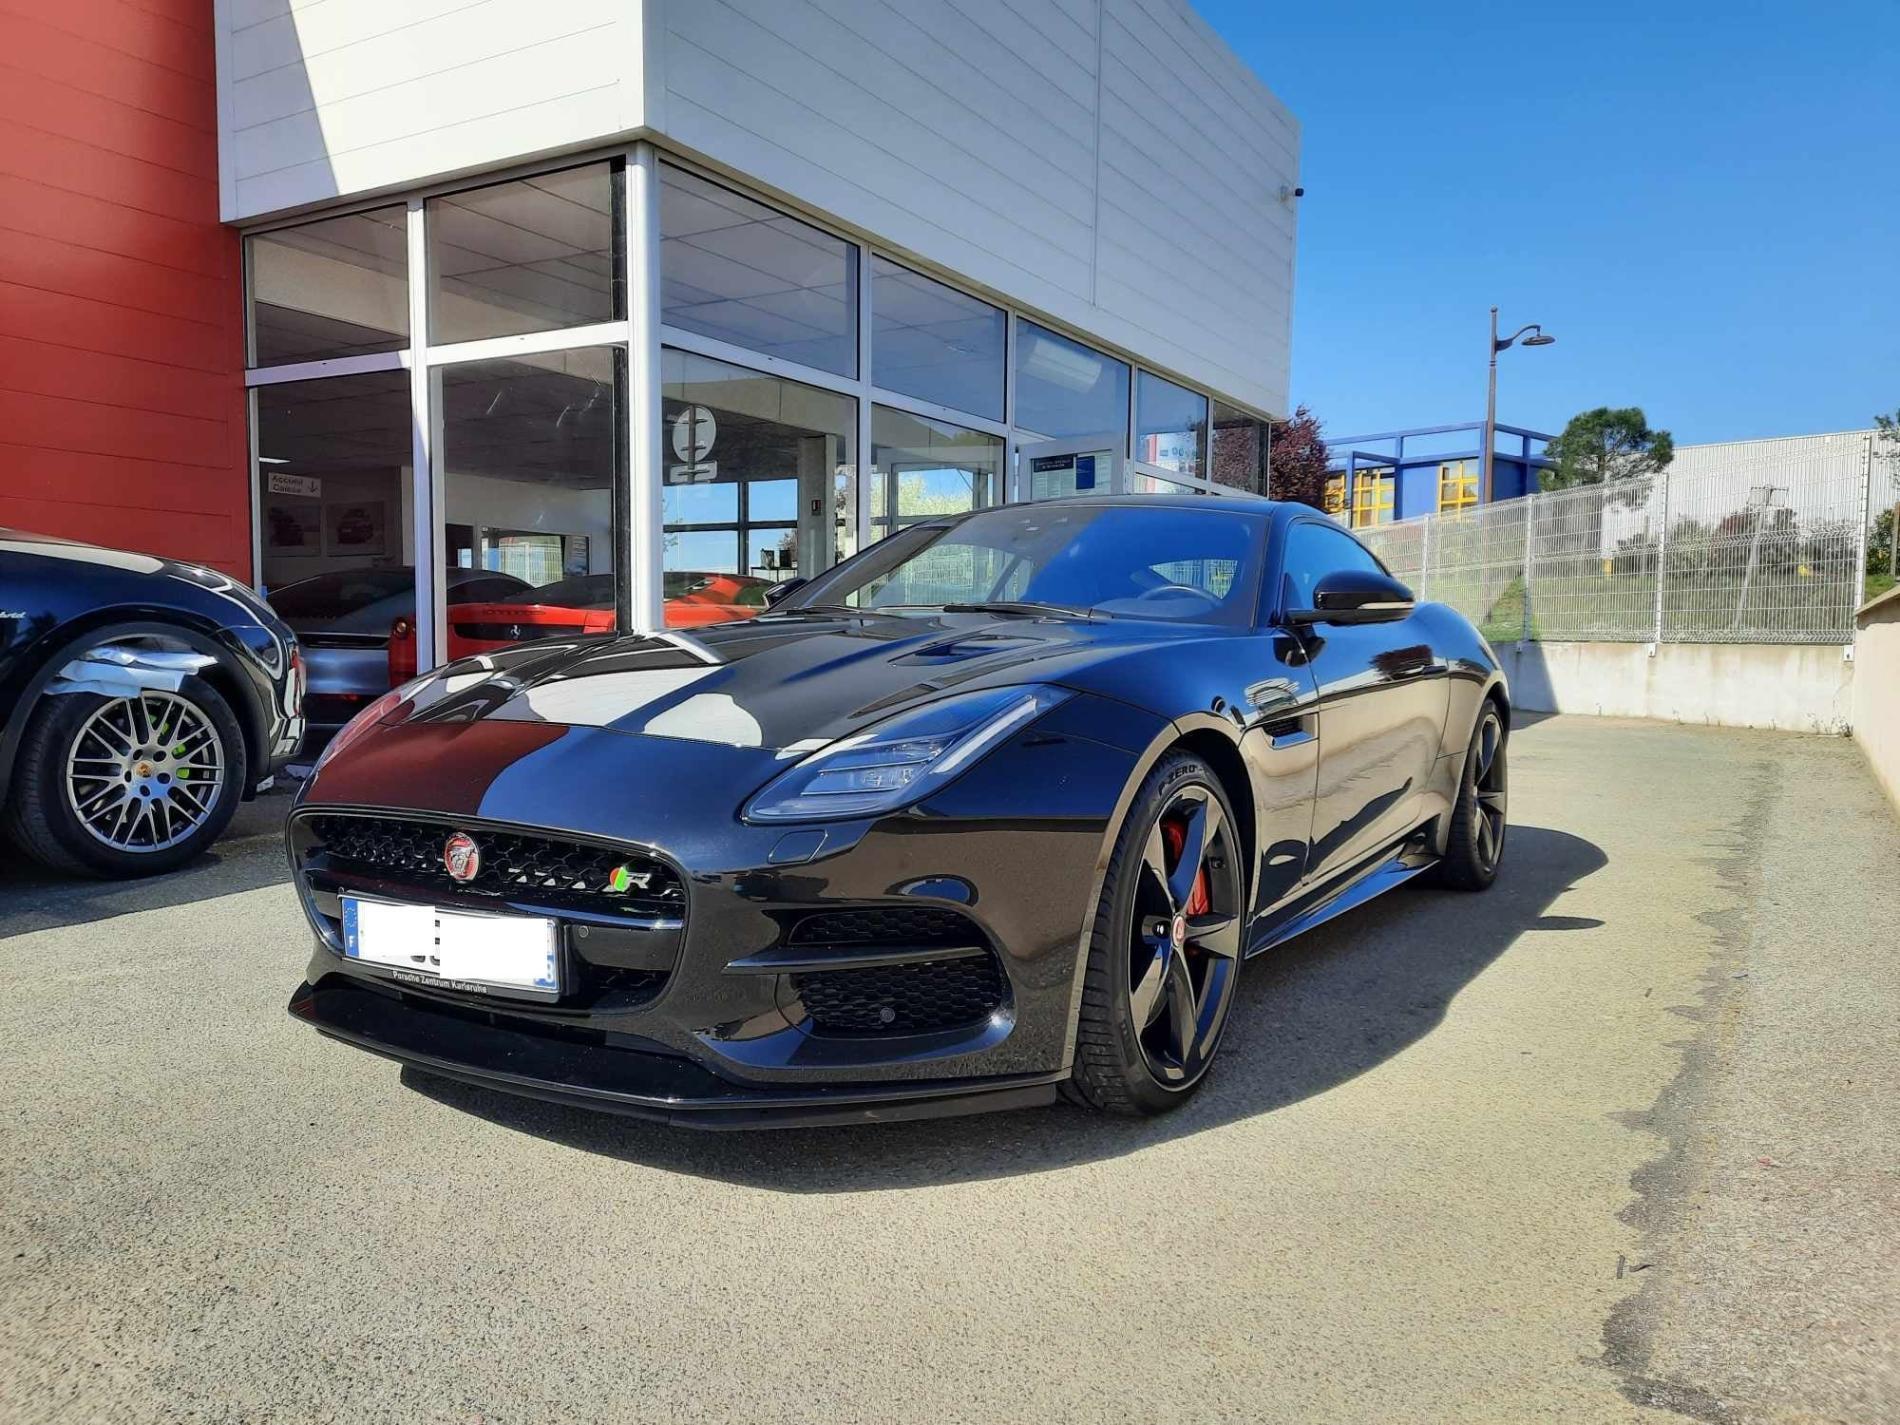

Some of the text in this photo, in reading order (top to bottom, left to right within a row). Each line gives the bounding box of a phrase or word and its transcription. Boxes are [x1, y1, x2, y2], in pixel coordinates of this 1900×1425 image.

[392, 970, 487, 994] Porsche Zentrum Karlsruhe
